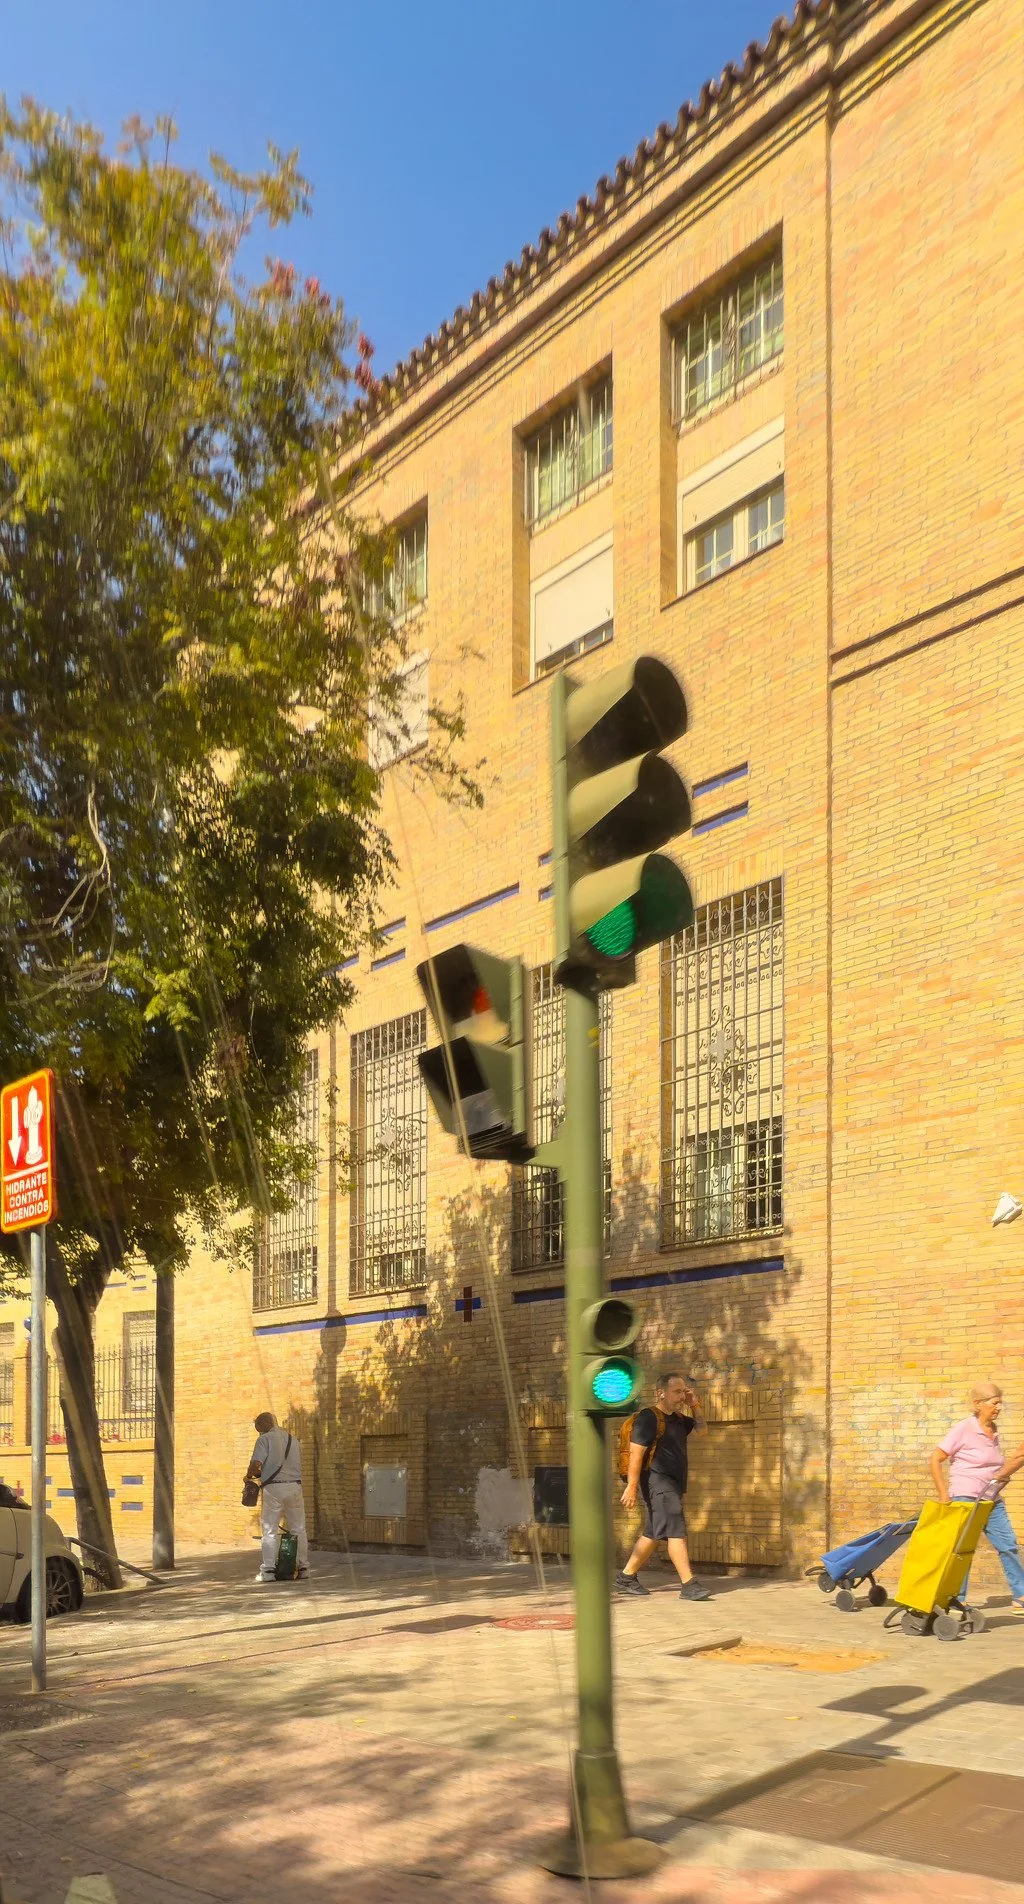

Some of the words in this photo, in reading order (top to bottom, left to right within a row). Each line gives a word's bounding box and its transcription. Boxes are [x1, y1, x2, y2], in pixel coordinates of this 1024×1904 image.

[6, 1172, 47, 1196] HIDRANTE
[10, 1187, 44, 1208] CONTRA
[4, 1200, 49, 1224] INCENDIOS
